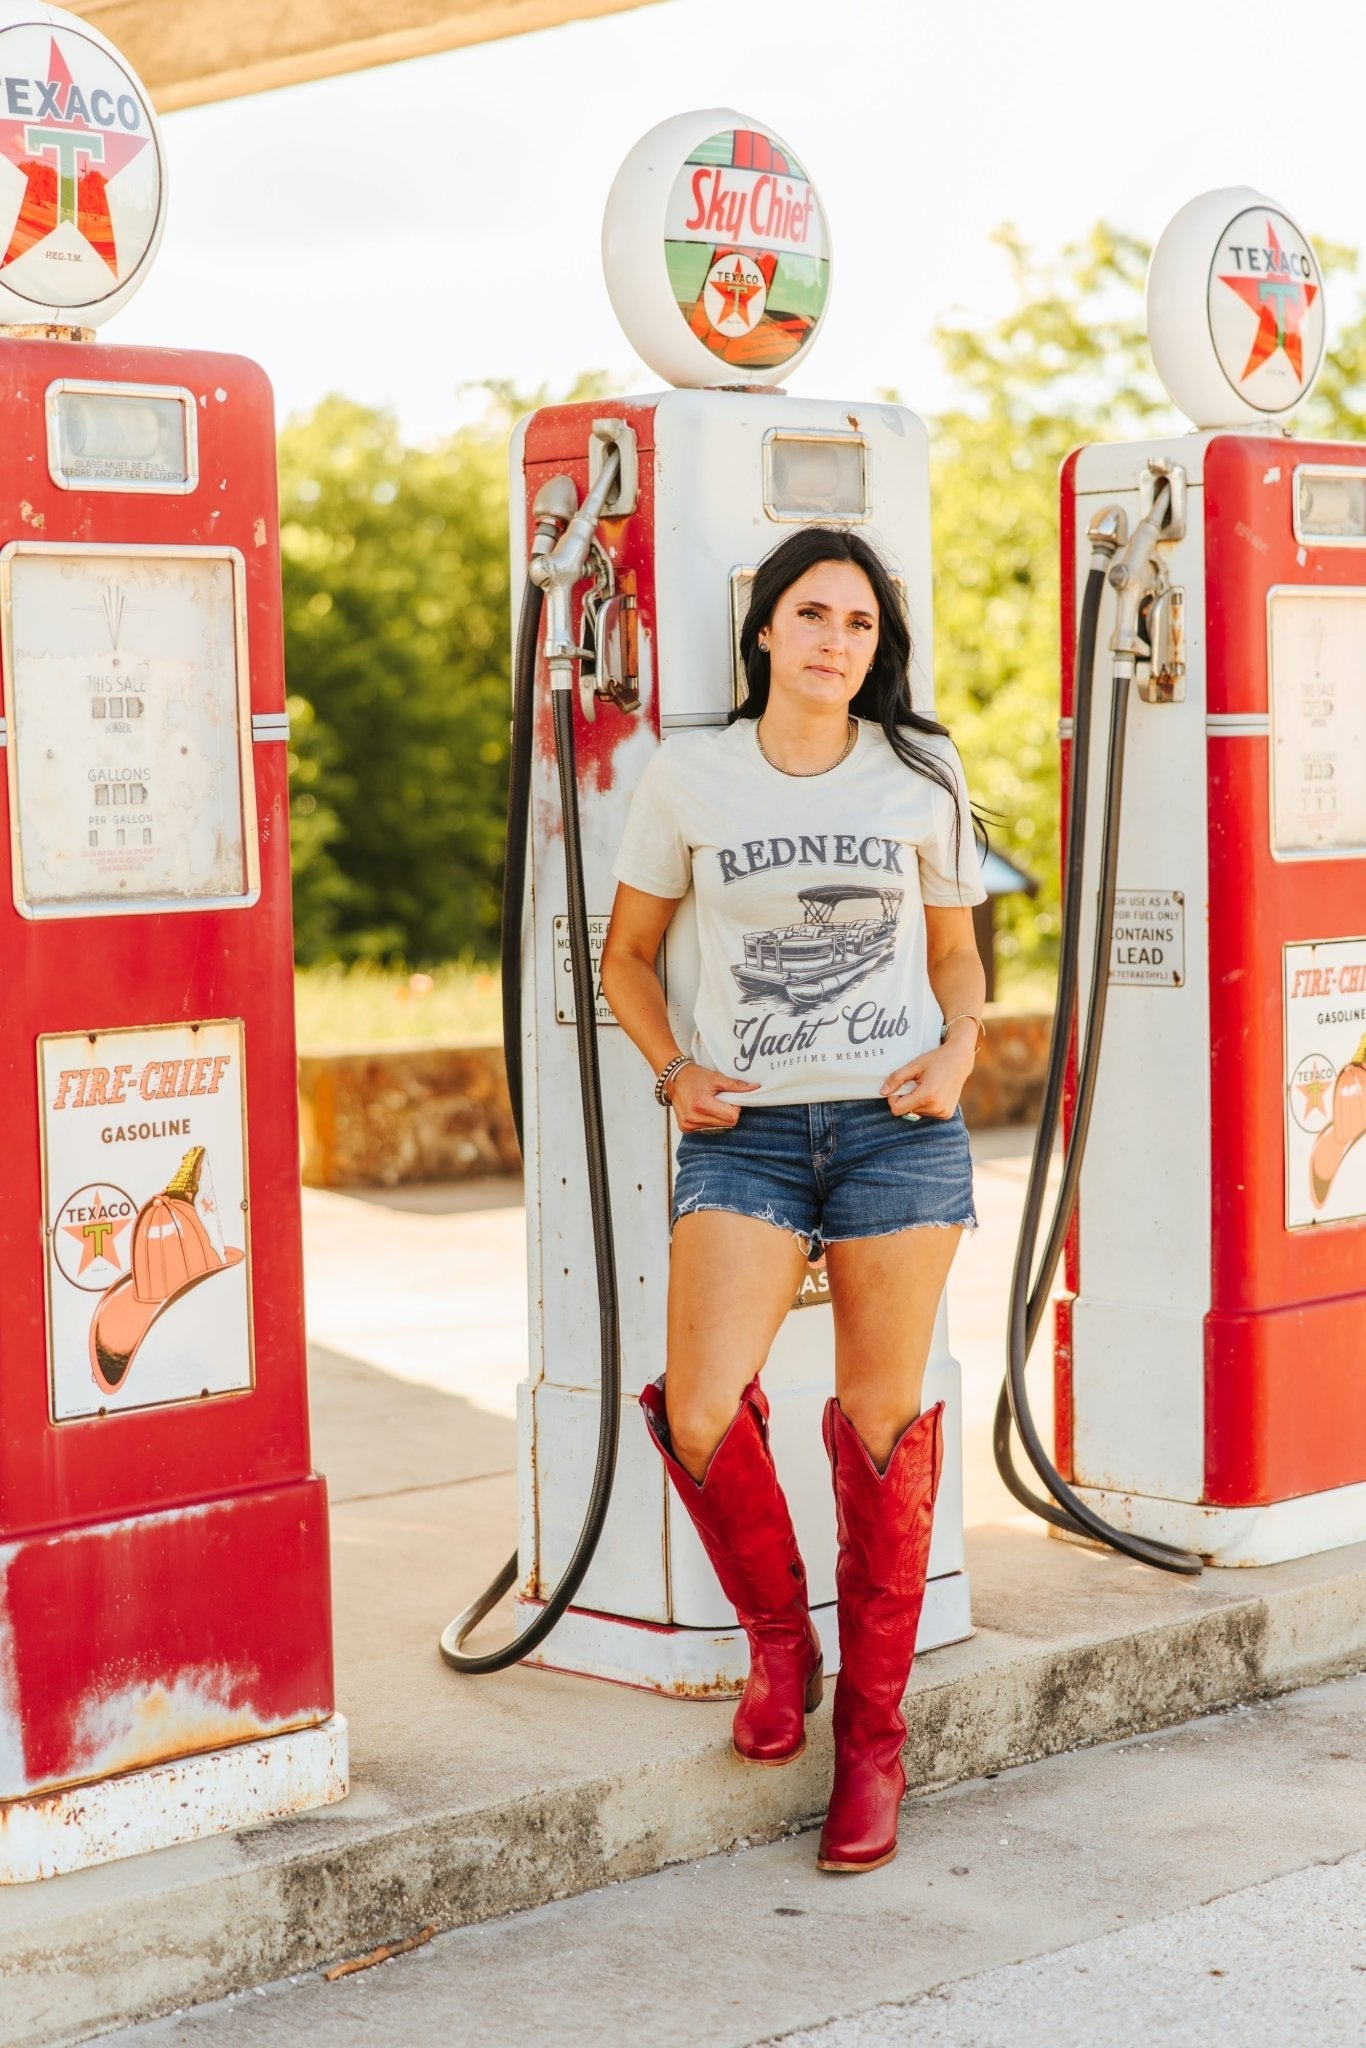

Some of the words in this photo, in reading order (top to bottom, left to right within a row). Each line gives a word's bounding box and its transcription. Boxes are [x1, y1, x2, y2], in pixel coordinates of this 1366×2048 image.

[0, 77, 140, 131] EXACO
[685, 168, 747, 242] Sky
[749, 174, 814, 243] Chief
[45, 250, 66, 261] REG.
[1229, 246, 1311, 278] TEXACO
[717, 271, 759, 285] TEXACO
[95, 469, 111, 478] AND
[114, 470, 140, 479] AFTER
[105, 461, 128, 471] MUST
[132, 463, 143, 471] BE
[146, 463, 167, 472] FULL
[116, 675, 147, 693] SALE
[88, 768, 151, 782] GALLONS
[88, 815, 107, 825] PER
[112, 814, 153, 825] GALLON
[716, 834, 904, 884] REDNECK
[1129, 898, 1146, 906] USE
[1149, 898, 1161, 906] AS
[1164, 898, 1170, 906] A
[1133, 911, 1154, 920] FUEL
[1157, 911, 1179, 920] ONLY
[1112, 927, 1174, 942] ONTAINS
[1117, 947, 1164, 965] LEAD
[733, 1013, 839, 1072] Yacht
[842, 1001, 911, 1045] Club
[770, 1053, 827, 1070] LIFETIME
[836, 1048, 886, 1062] MEMBER
[53, 1055, 231, 1110] FIRE-CHIEF
[1298, 1068, 1334, 1082] TEXACO
[101, 1118, 191, 1144] GASOLINE
[66, 1202, 131, 1223] TEXACO
